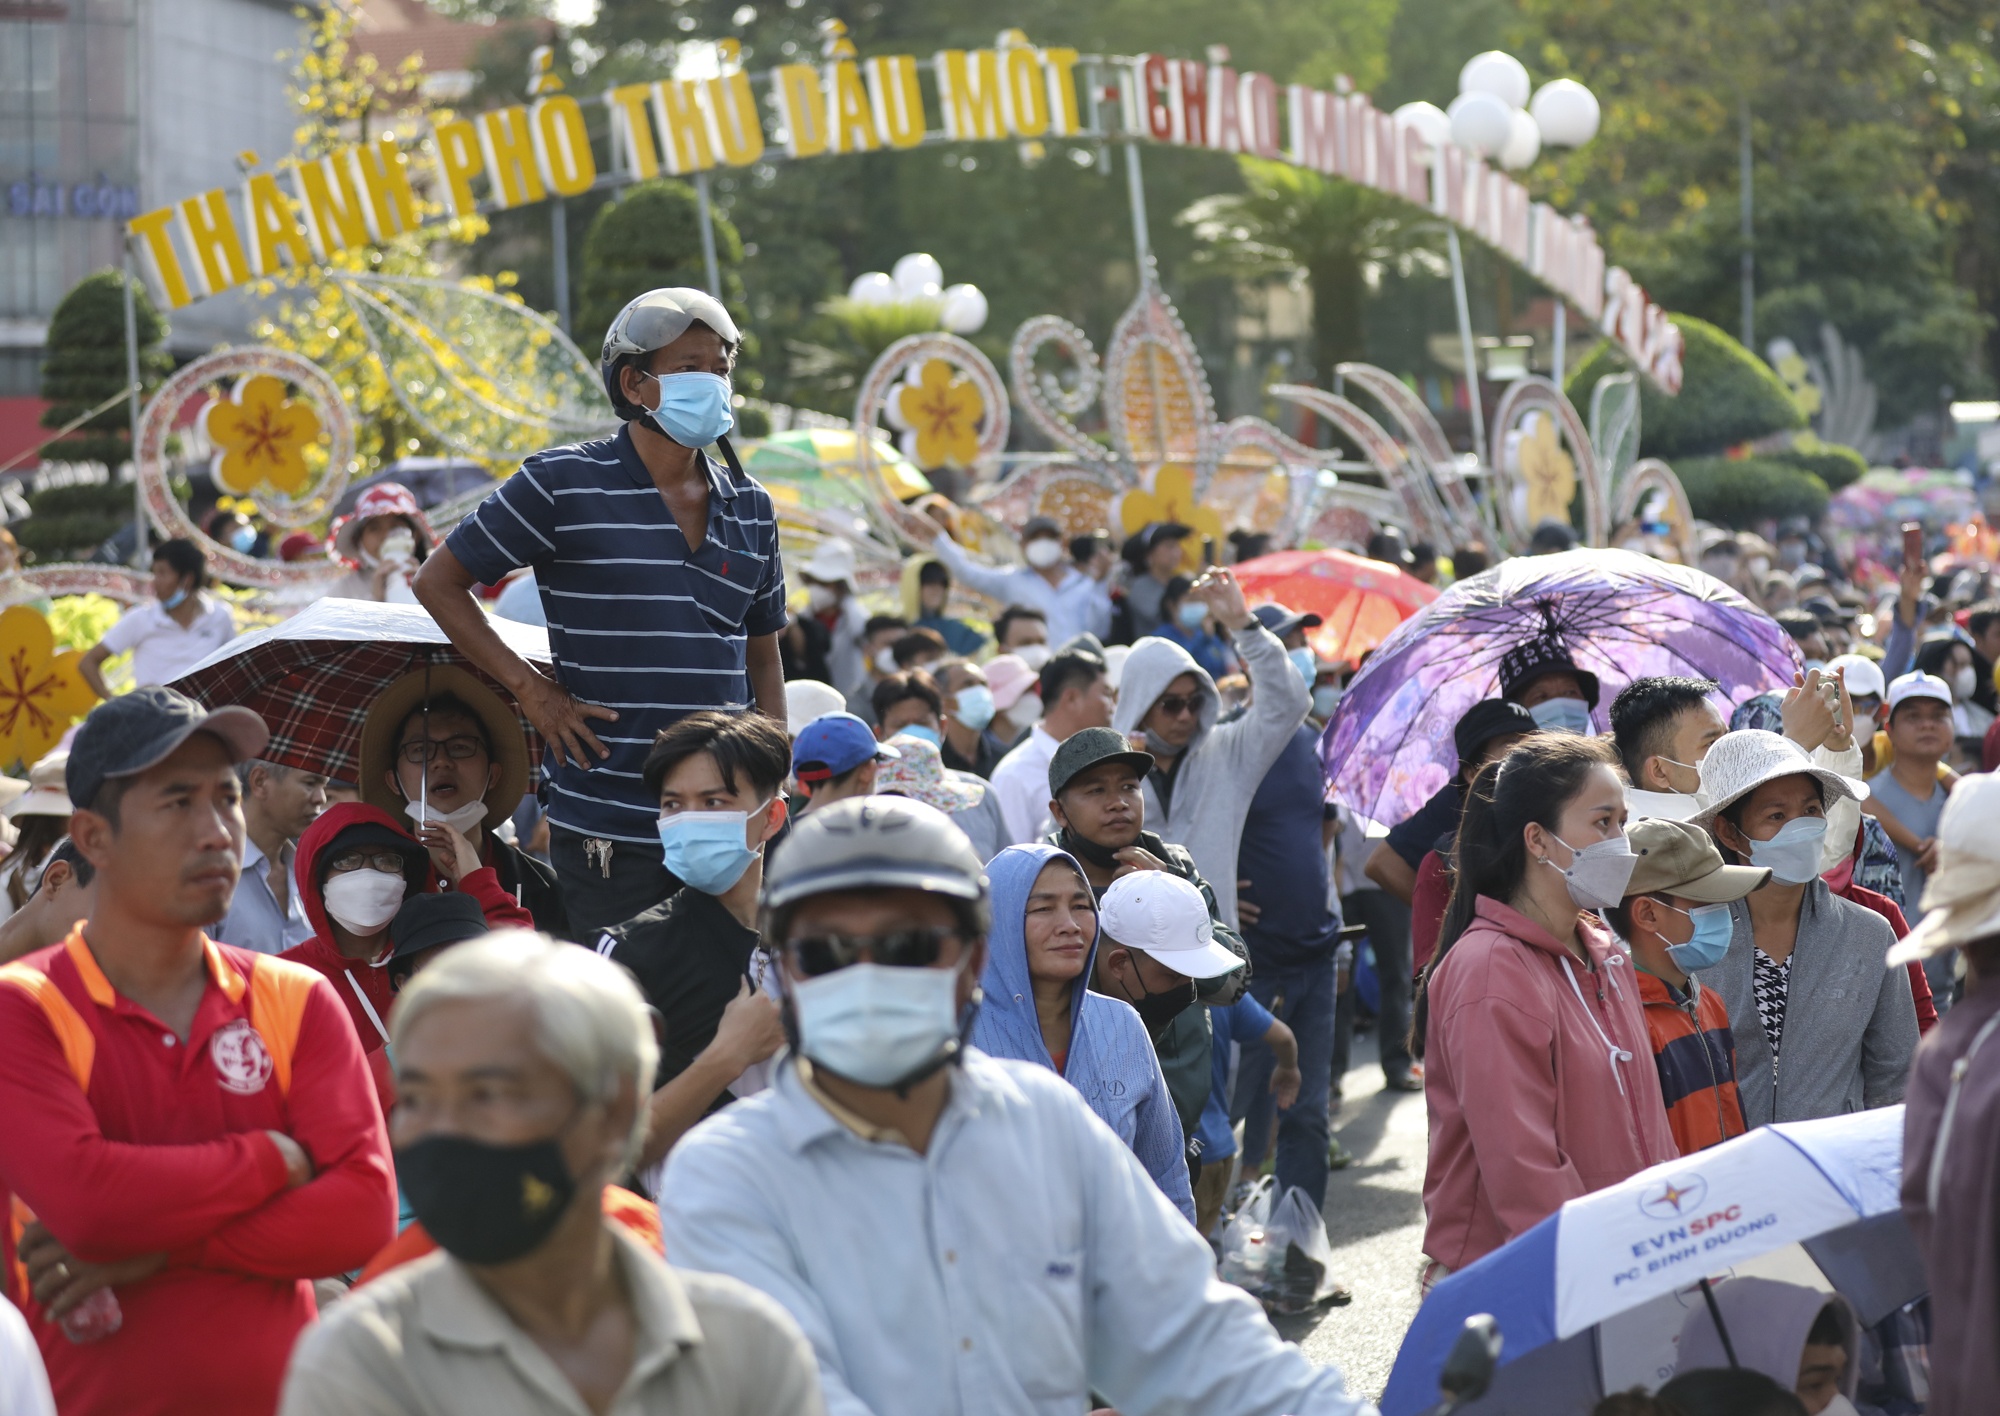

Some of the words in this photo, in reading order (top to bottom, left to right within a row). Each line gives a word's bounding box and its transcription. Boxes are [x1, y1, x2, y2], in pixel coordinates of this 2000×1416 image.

[127, 138, 421, 310] THÀNH
[431, 45, 597, 216] PHỐ
[605, 37, 765, 181] THỦ
[772, 17, 926, 158] DẦU
[933, 28, 1080, 163] MỘT
[1132, 44, 1281, 158] CHÀO
[1613, 1267, 1641, 1286] PC
[1647, 1244, 1698, 1273] BINH
[1704, 1213, 1778, 1250] DUONG
[1631, 1203, 1742, 1259] EVNSPC
